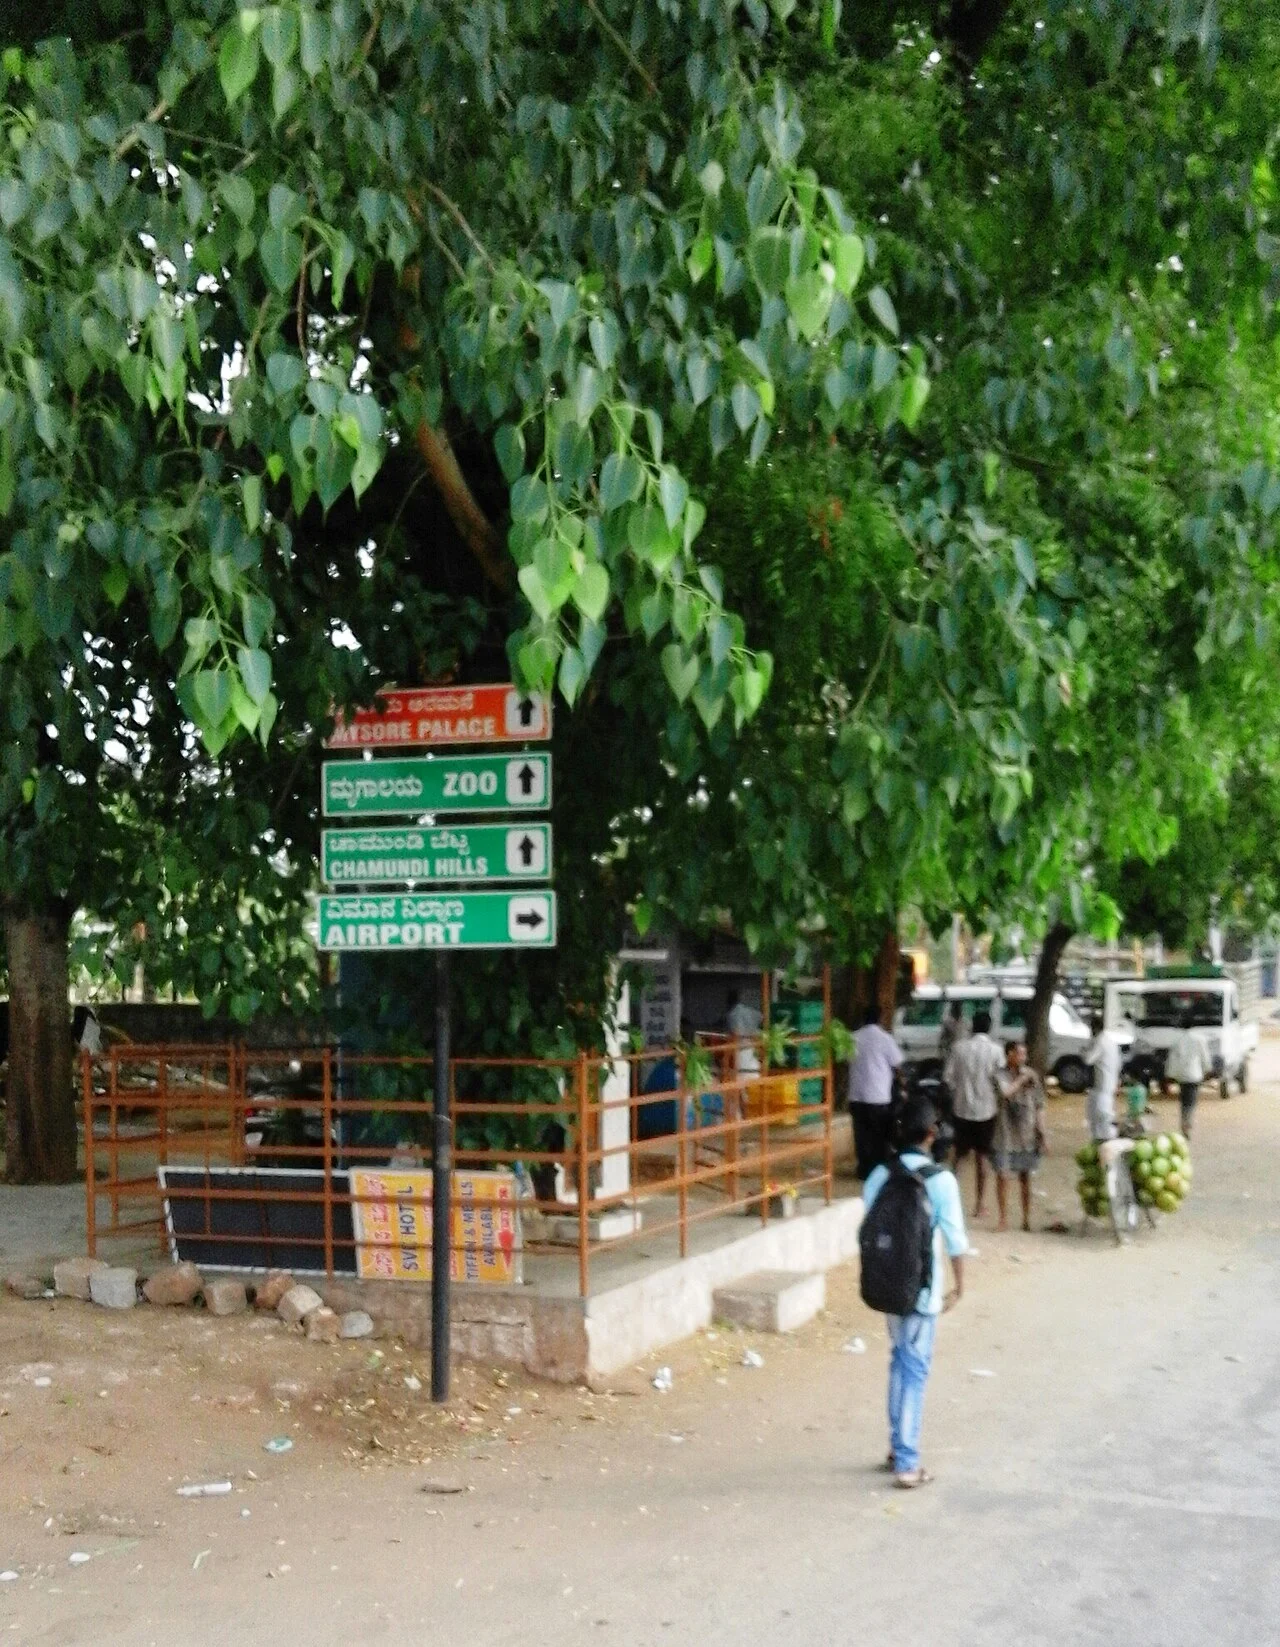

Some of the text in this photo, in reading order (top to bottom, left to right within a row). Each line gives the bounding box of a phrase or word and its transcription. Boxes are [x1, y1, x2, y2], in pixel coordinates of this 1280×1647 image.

[417, 716, 496, 738] PALACE
[442, 770, 498, 797] ZOO
[329, 857, 488, 879] CHAMUNDI HILLS
[325, 922, 465, 946] AIRPORT
[397, 1185, 416, 1236] HOTL
[460, 1181, 475, 1222] MELS
